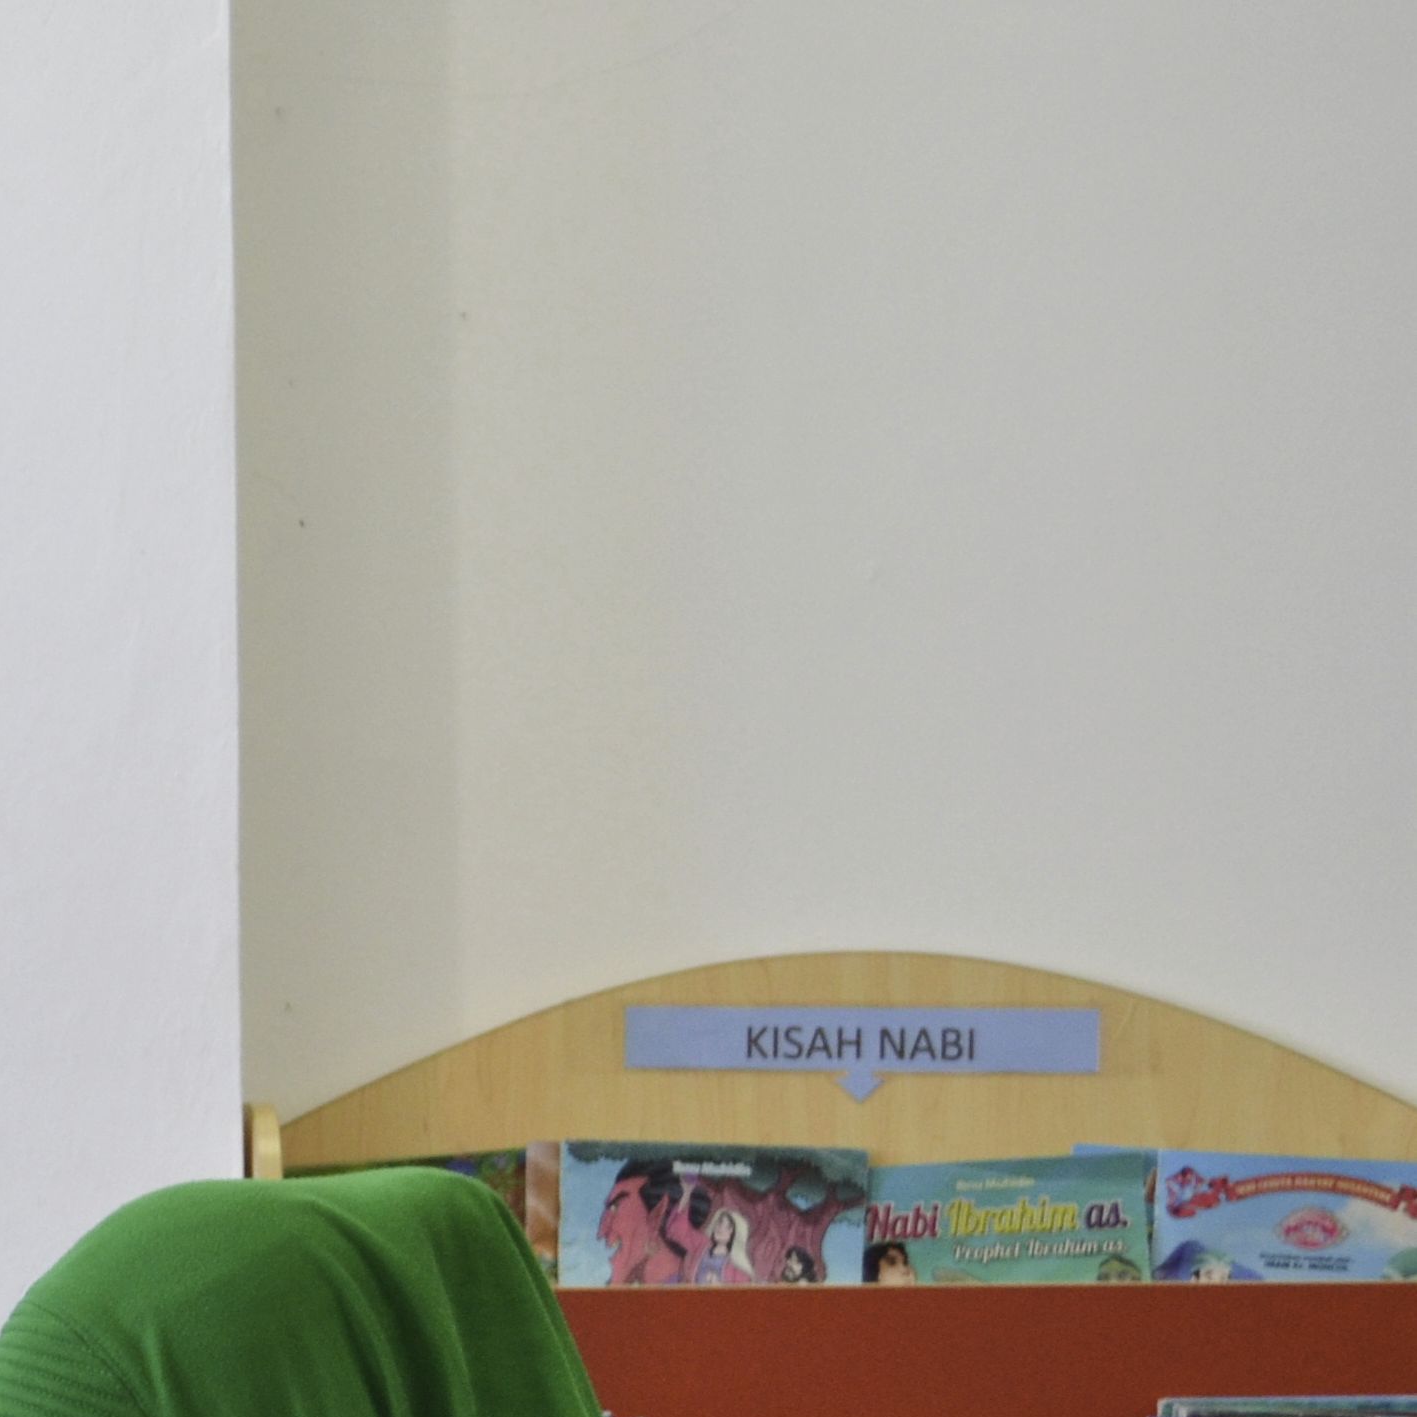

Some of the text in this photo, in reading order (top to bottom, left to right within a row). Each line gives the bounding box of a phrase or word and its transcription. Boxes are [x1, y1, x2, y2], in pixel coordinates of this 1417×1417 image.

[746, 1025, 975, 1061] KISAH NABI
[866, 1202, 941, 1242] Nabi
[947, 1195, 1079, 1238] Ibrahim
